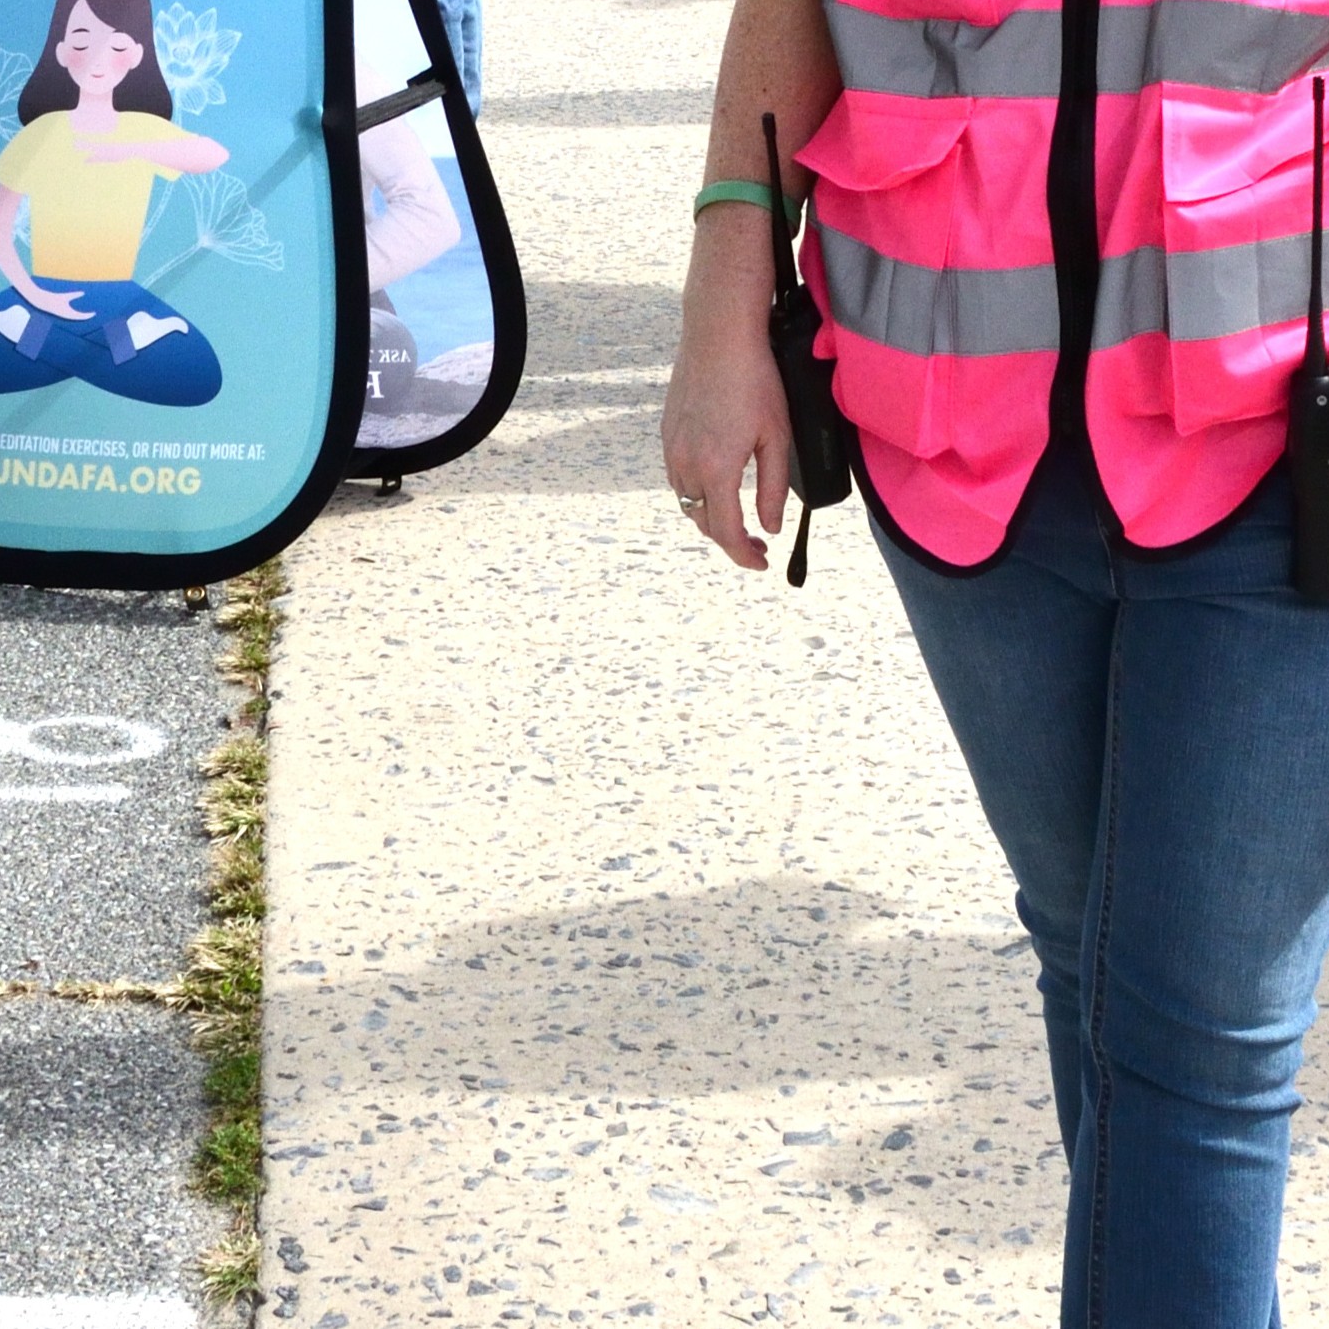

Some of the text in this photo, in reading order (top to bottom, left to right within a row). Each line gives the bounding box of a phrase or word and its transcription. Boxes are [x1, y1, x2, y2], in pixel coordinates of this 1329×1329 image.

[61, 438, 129, 460] EXERCISES,
[132, 441, 150, 458] OR
[152, 442, 181, 459] FIND
[183, 442, 208, 460] OUT
[210, 443, 246, 461] MORE
[247, 444, 266, 461] AT:
